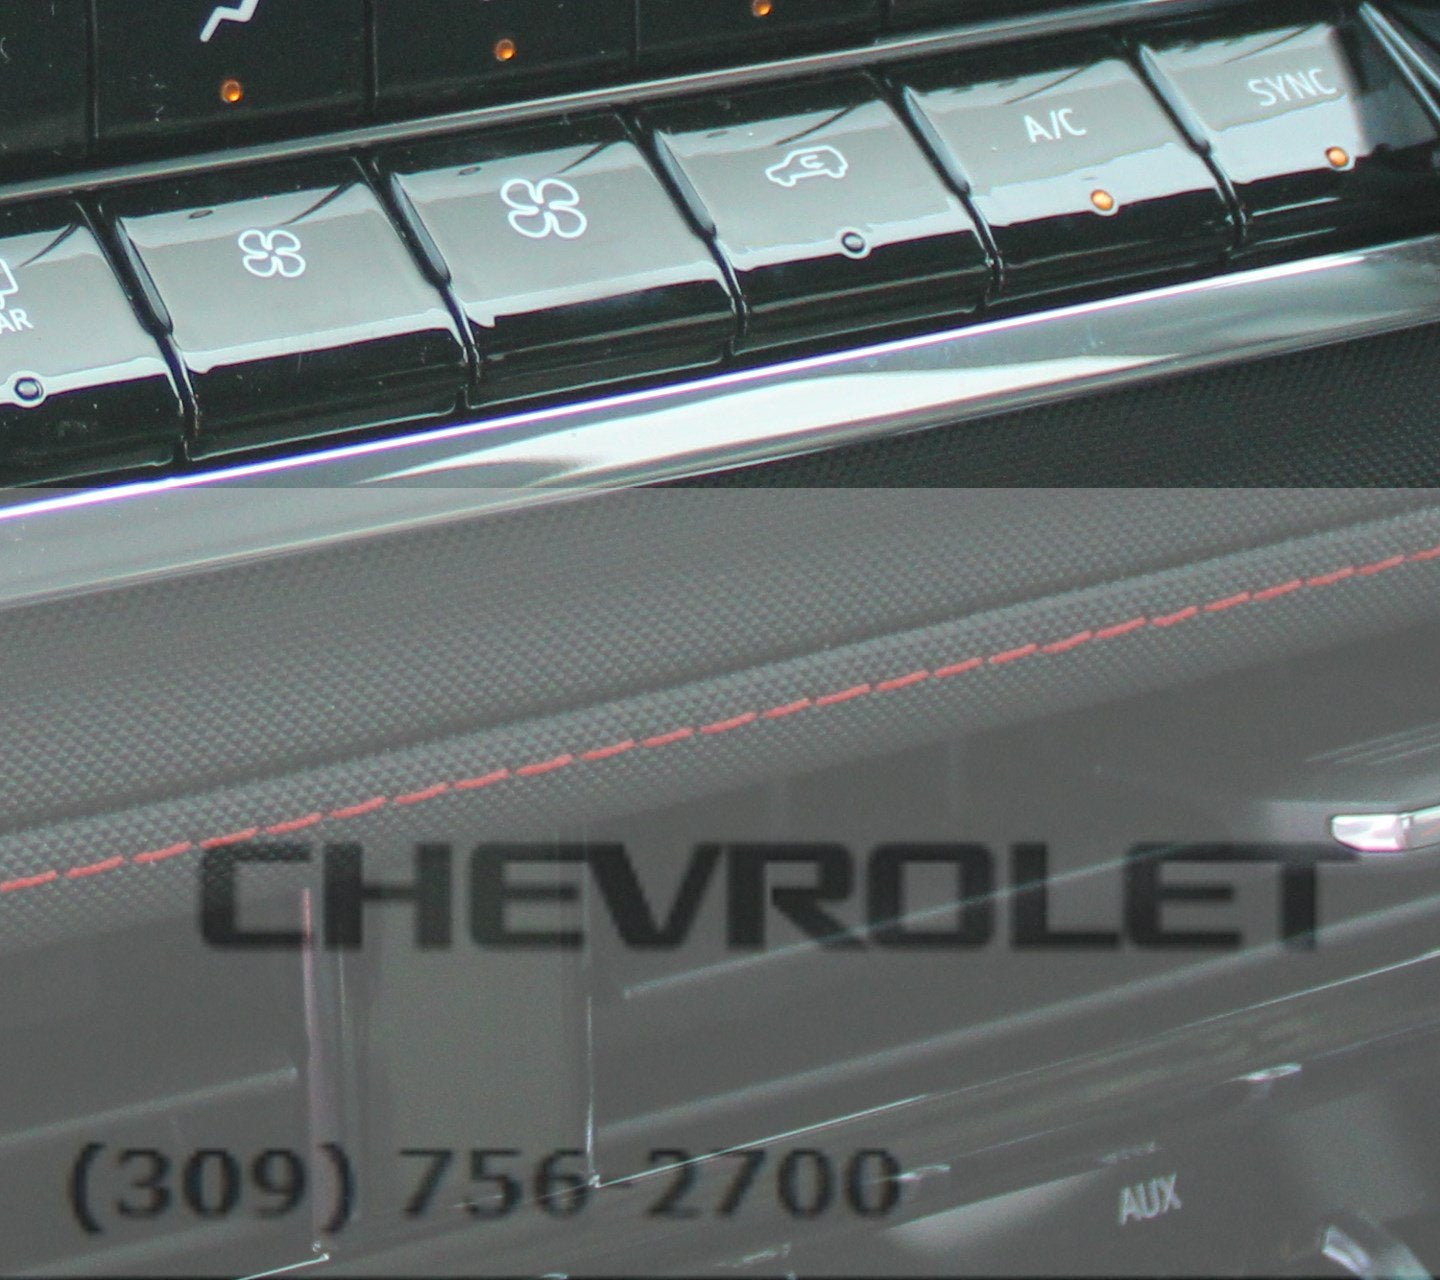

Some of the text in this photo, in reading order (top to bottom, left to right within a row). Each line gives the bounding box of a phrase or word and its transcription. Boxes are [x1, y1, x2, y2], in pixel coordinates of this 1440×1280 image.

[1247, 65, 1337, 107] SYNC
[1025, 107, 1087, 143] A/C
[1119, 1173, 1182, 1227] AUX
